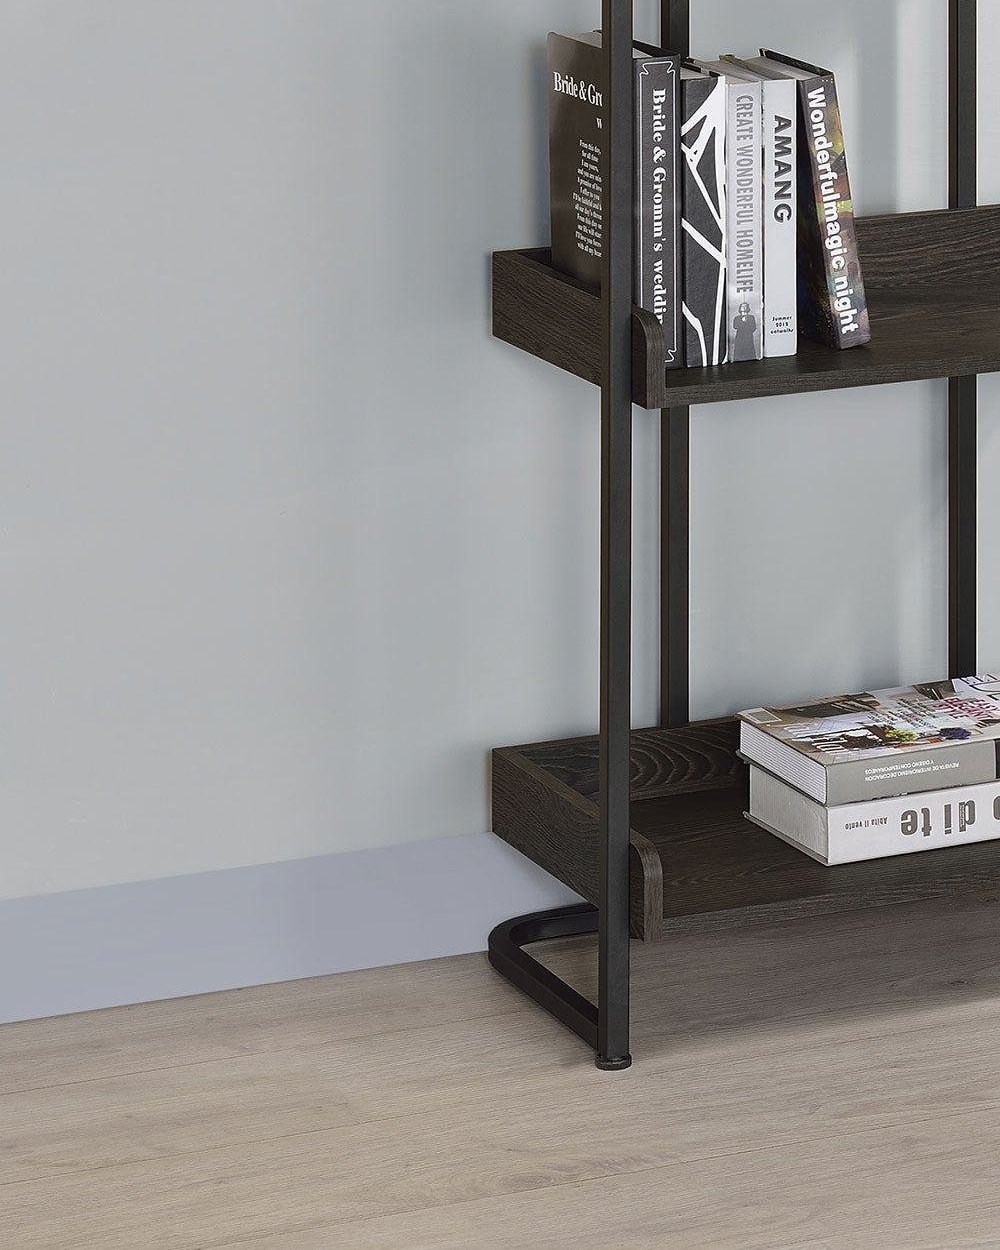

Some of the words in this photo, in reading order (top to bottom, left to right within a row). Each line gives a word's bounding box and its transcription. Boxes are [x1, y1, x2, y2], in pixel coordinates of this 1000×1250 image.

[553, 71, 578, 98] Bride
[579, 80, 587, 101] &
[652, 88, 667, 143] Bride
[735, 95, 754, 141] CREATE
[652, 146, 666, 163] &
[773, 114, 792, 223] AMANG
[652, 166, 667, 252] Gromm's
[735, 144, 754, 226] WONDERFUL
[735, 229, 754, 294] HOMELIFE
[834, 275, 859, 335] night
[900, 809, 933, 837] te
[944, 799, 976, 836] di
